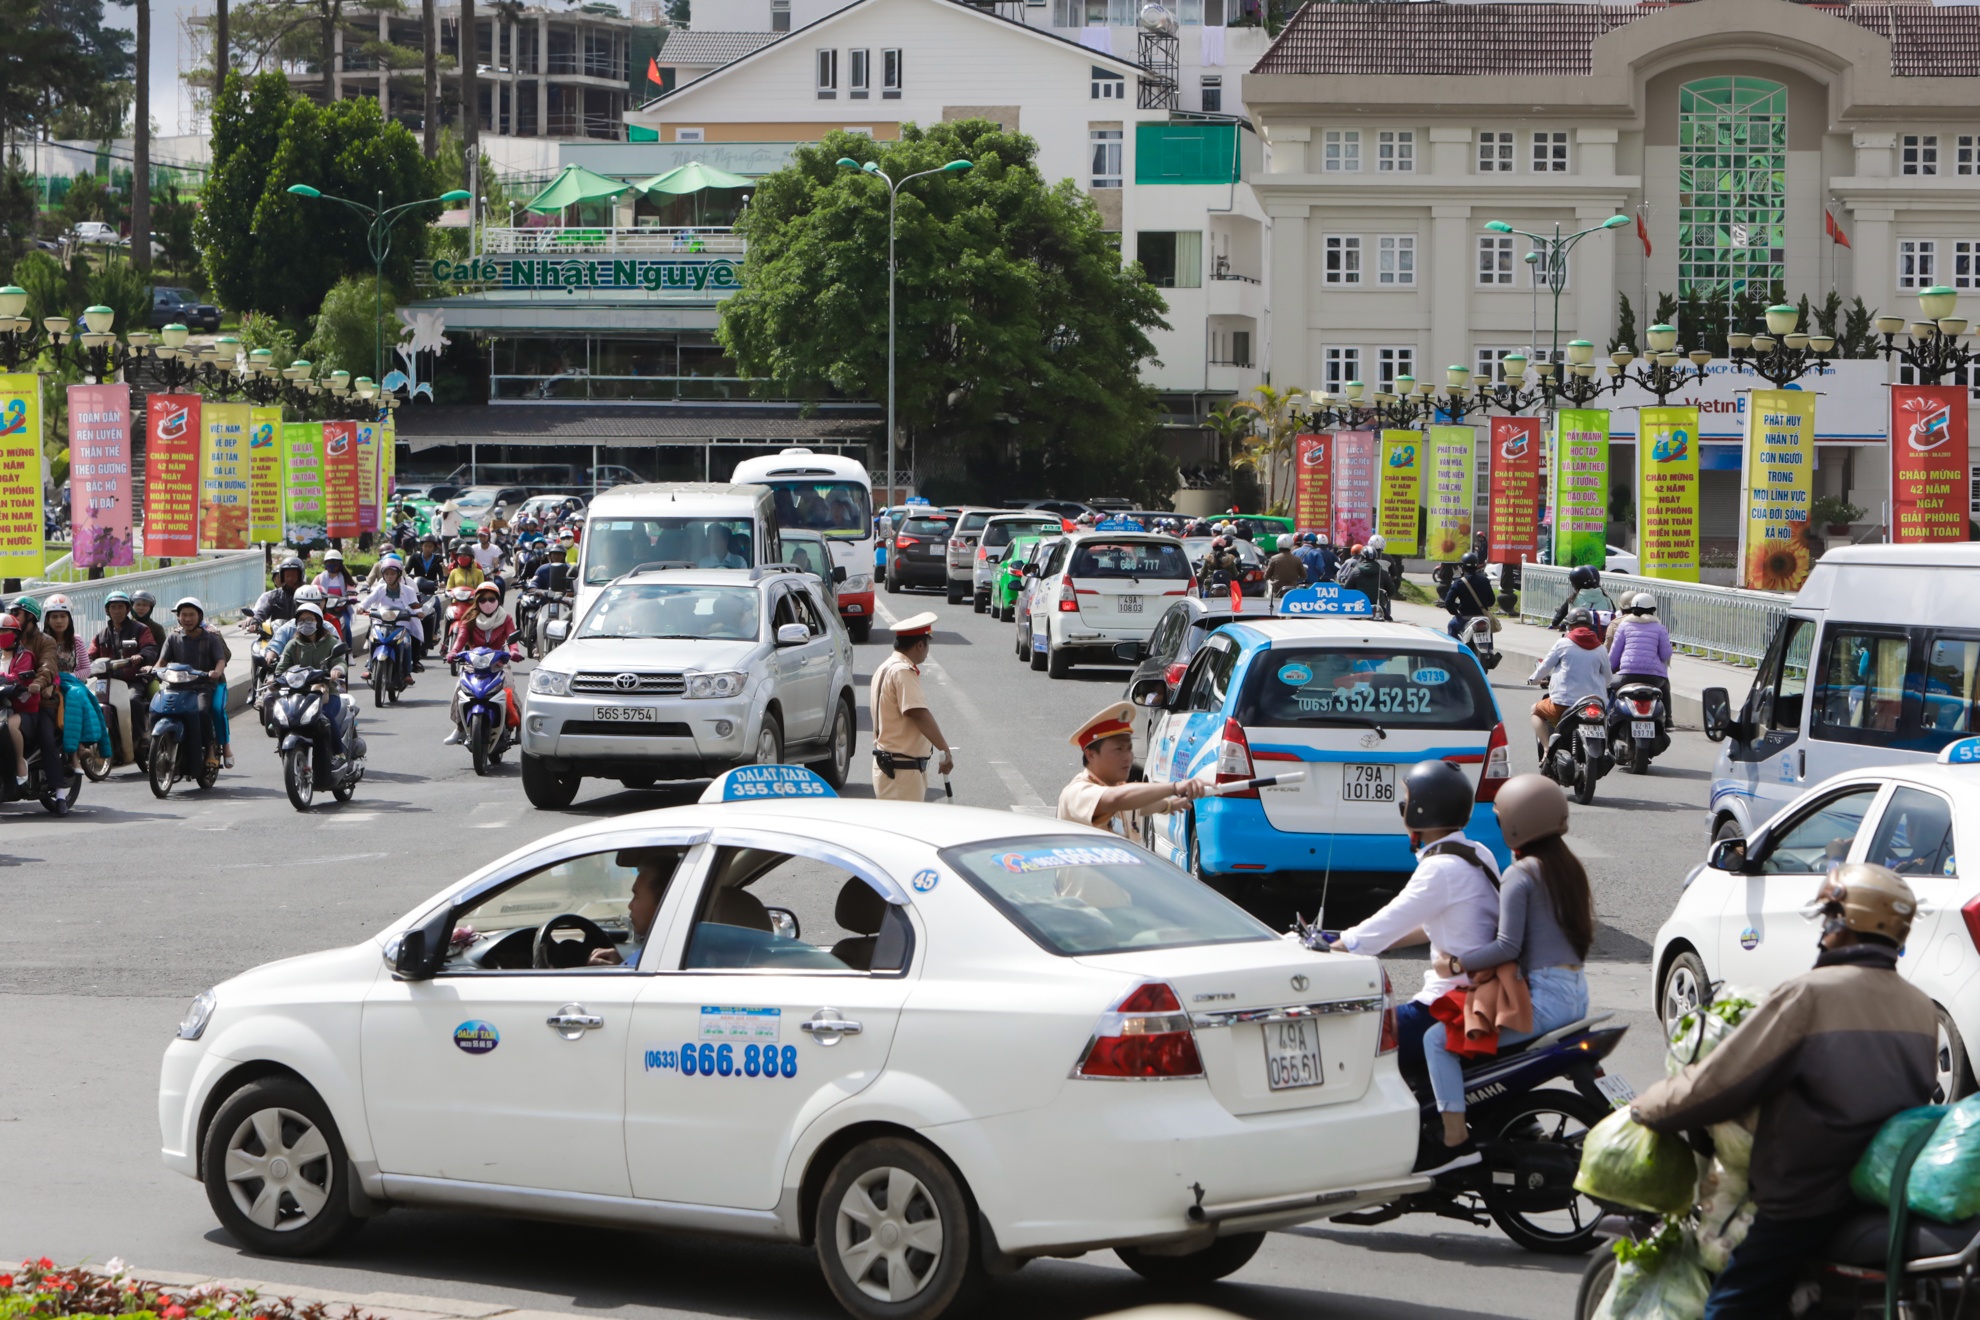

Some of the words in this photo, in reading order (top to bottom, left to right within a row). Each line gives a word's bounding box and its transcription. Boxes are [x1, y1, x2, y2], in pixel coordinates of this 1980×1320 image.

[432, 258, 497, 282] Café
[512, 259, 598, 294] Nhật
[613, 259, 742, 290] Nguyê
[1731, 366, 1754, 376] Cng
[1646, 473, 1667, 481] CHÀO
[1670, 473, 1693, 481] MỪNG
[1899, 469, 1926, 479] CHÀO
[1930, 469, 1961, 480] MỪNG
[1667, 484, 1685, 492] NĂM
[1910, 486, 1922, 494] 42
[1926, 483, 1949, 493] NĂM
[1917, 497, 1944, 508] NGÀY
[1647, 506, 1662, 514] GIẢI
[1665, 506, 1692, 514] PHÓNG
[1647, 517, 1669, 525] HOÀN
[1672, 517, 1692, 525] TOÀN
[1901, 511, 1921, 522] GIẢI
[1925, 511, 1959, 522] PHÓNG
[1649, 528, 1669, 536] MIỀN
[1902, 525, 1929, 536] HOÀN
[1933, 525, 1960, 536] TOÀN
[1645, 538, 1671, 548] THỐNG
[1674, 538, 1694, 548] NHẤT
[1650, 549, 1665, 559] ĐẤT
[1316, 587, 1338, 597] TAXI
[1289, 599, 1338, 612] QUỐC
[1342, 599, 1365, 612] TẾ
[1416, 671, 1444, 681] 49739
[597, 708, 652, 720] 56S-5754
[736, 768, 777, 782] DALAT
[780, 768, 811, 780] TAXI
[1356, 766, 1382, 782] 79A
[732, 782, 824, 796] 355.66.55
[1346, 783, 1392, 799] 101.86
[913, 872, 937, 890] 45
[1280, 1023, 1306, 1052] 49A
[680, 1043, 797, 1078] 666.888
[1465, 1082, 1507, 1106] MAHA
